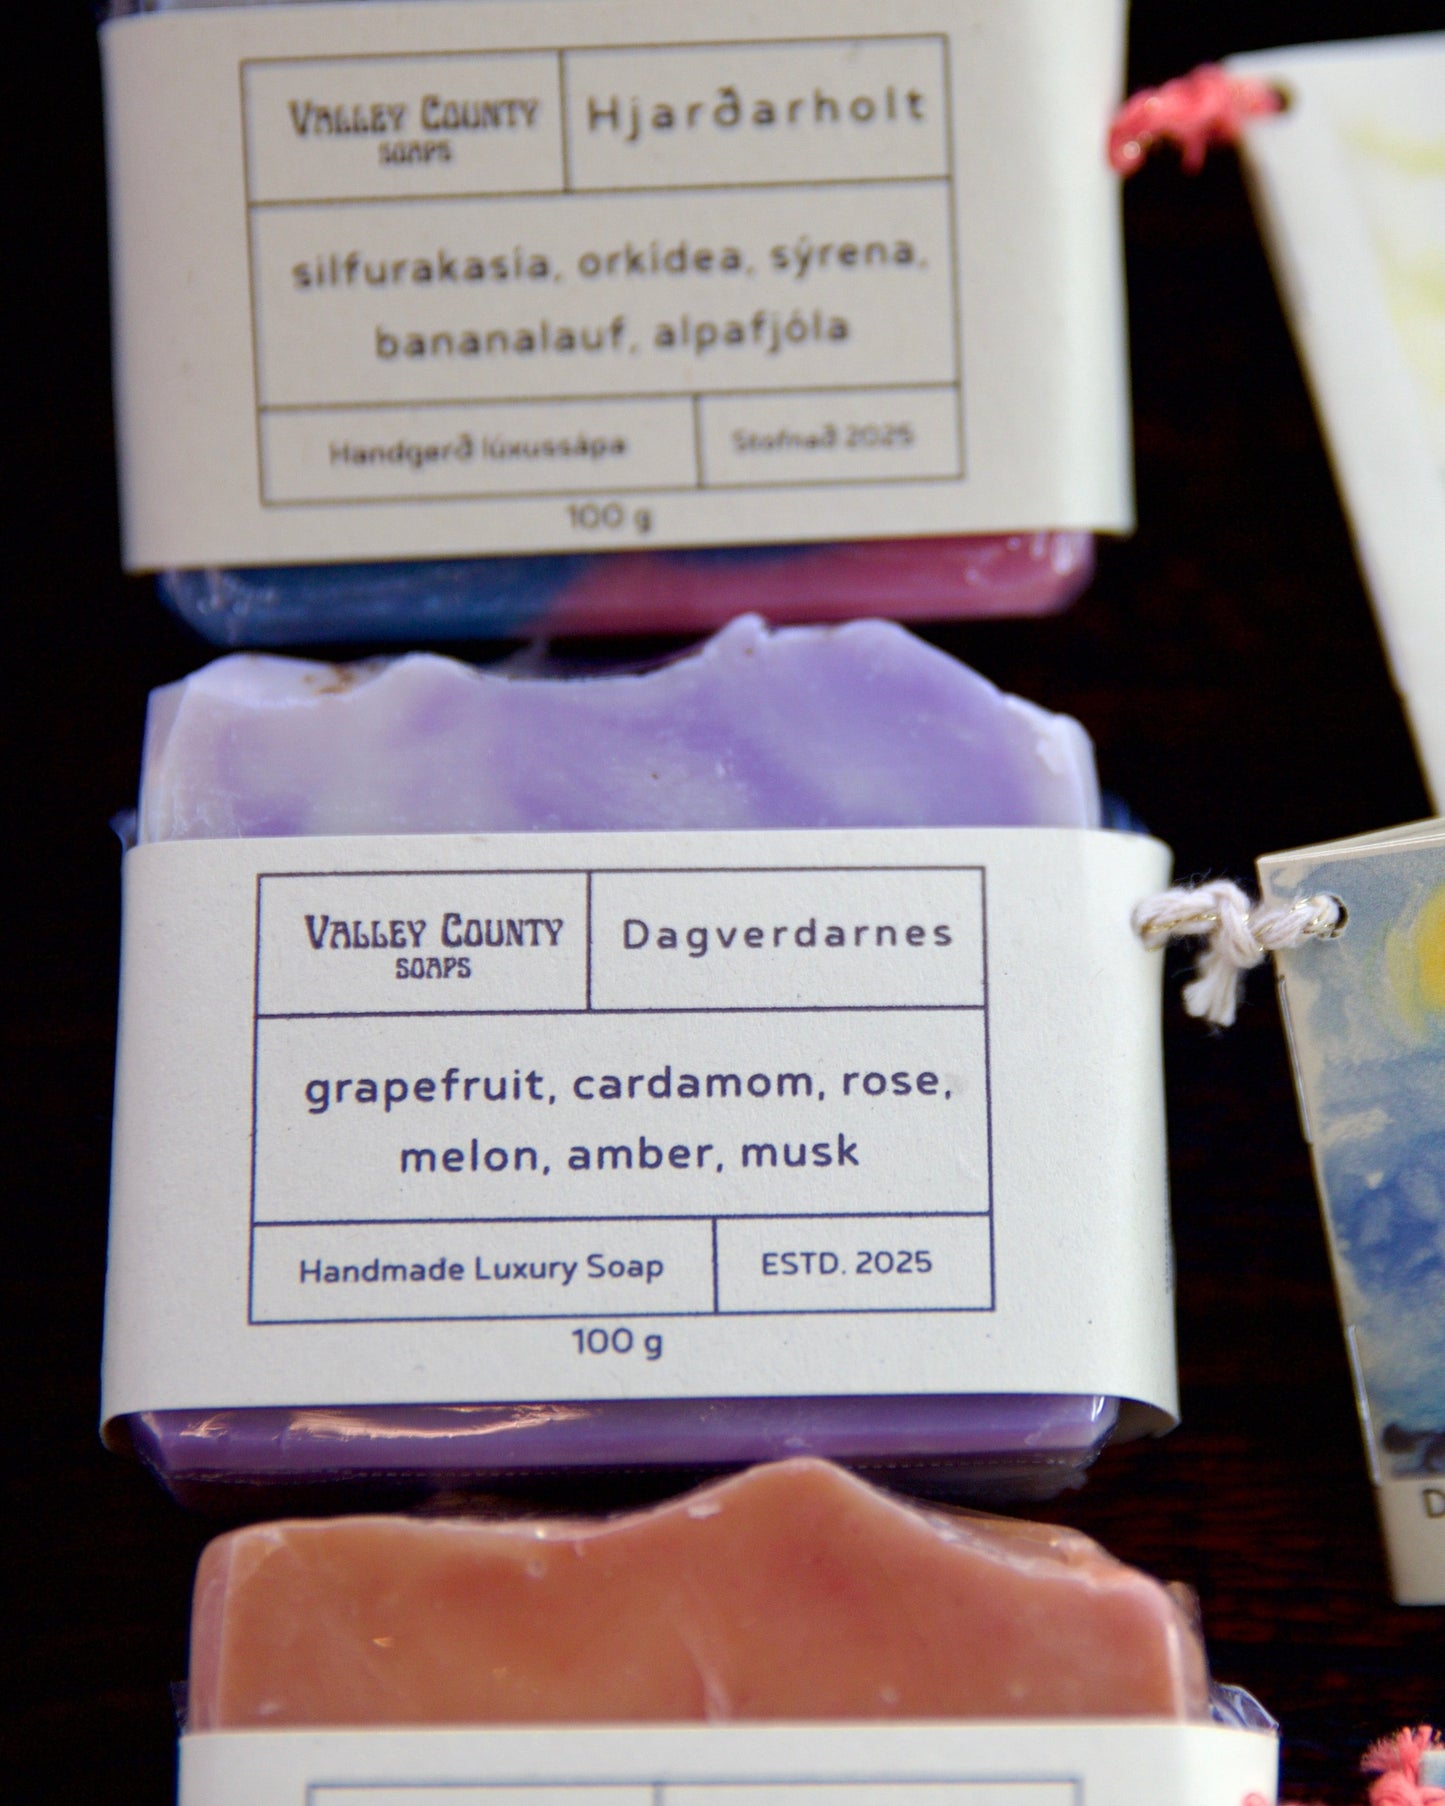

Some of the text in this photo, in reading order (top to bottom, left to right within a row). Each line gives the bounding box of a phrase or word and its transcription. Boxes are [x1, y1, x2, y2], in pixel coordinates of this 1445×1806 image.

[288, 93, 540, 138] VALLEY COUNTY
[586, 84, 925, 146] Hjarðarholt
[377, 138, 454, 166] SOAPS
[374, 309, 852, 362] bananalauf, alpafjóla
[328, 432, 476, 471] Handgerð
[843, 421, 917, 452] 2025
[566, 502, 655, 537] 100 g
[303, 911, 565, 951] VALLEY COUNTY
[622, 916, 953, 959] Dagverdarnes
[395, 955, 473, 980] SOAPS
[304, 1064, 953, 1116] grapefruit, cardamom, rose,
[400, 1132, 860, 1177] melon, amber, musk
[299, 1252, 665, 1287] Handmade Luxury Soap
[761, 1249, 933, 1277] ESTD. 2025
[571, 1326, 664, 1362] 100 g
